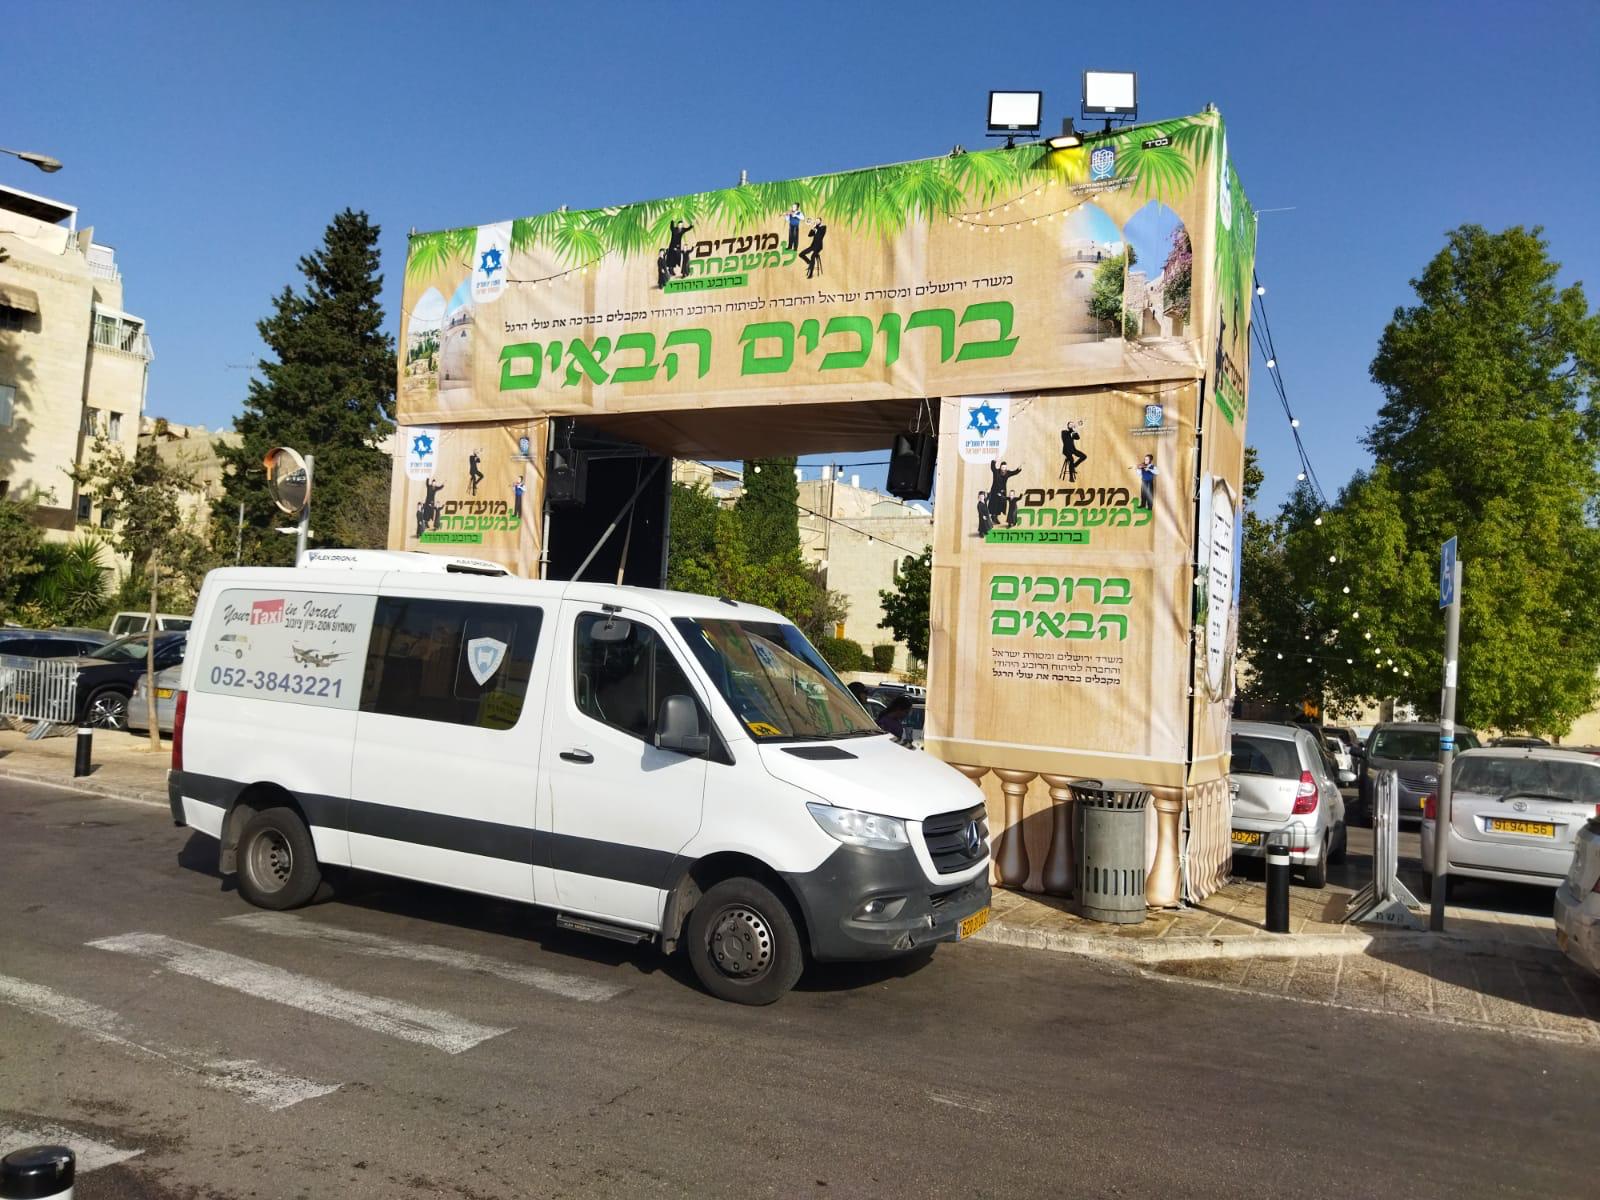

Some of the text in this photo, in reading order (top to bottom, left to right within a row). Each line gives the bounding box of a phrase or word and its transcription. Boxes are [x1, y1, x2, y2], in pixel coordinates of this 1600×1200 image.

[688, 240, 798, 276] למשפחה
[694, 233, 779, 258] מועדים
[669, 276, 743, 291] ברובע היהודי
[504, 274, 1013, 333] משרד ירושלים ומסורת ישראל והחברה לפיתוח הרובע היהודי מקבלים בברכה את עולי הרגל
[497, 301, 1020, 393] ברוכים הבאים
[444, 500, 508, 515] מועדים
[1024, 488, 1130, 507] מועדים
[439, 508, 522, 531] למשפחה
[1016, 497, 1152, 527] למשפחה
[992, 531, 1083, 543] ברובע היהודי
[989, 575, 1134, 605] ברוכים
[224, 600, 342, 626] Your Taxi in Israel
[990, 609, 1128, 642] הבאים
[992, 647, 1124, 664] משרד ירושלים ומסורת ישראל
[994, 661, 1121, 674] והחברה לפיתוח הרובע היהודי
[210, 665, 343, 699] 052-3843221
[992, 668, 1121, 685] מקבלים בברכה את עולי הרגל
